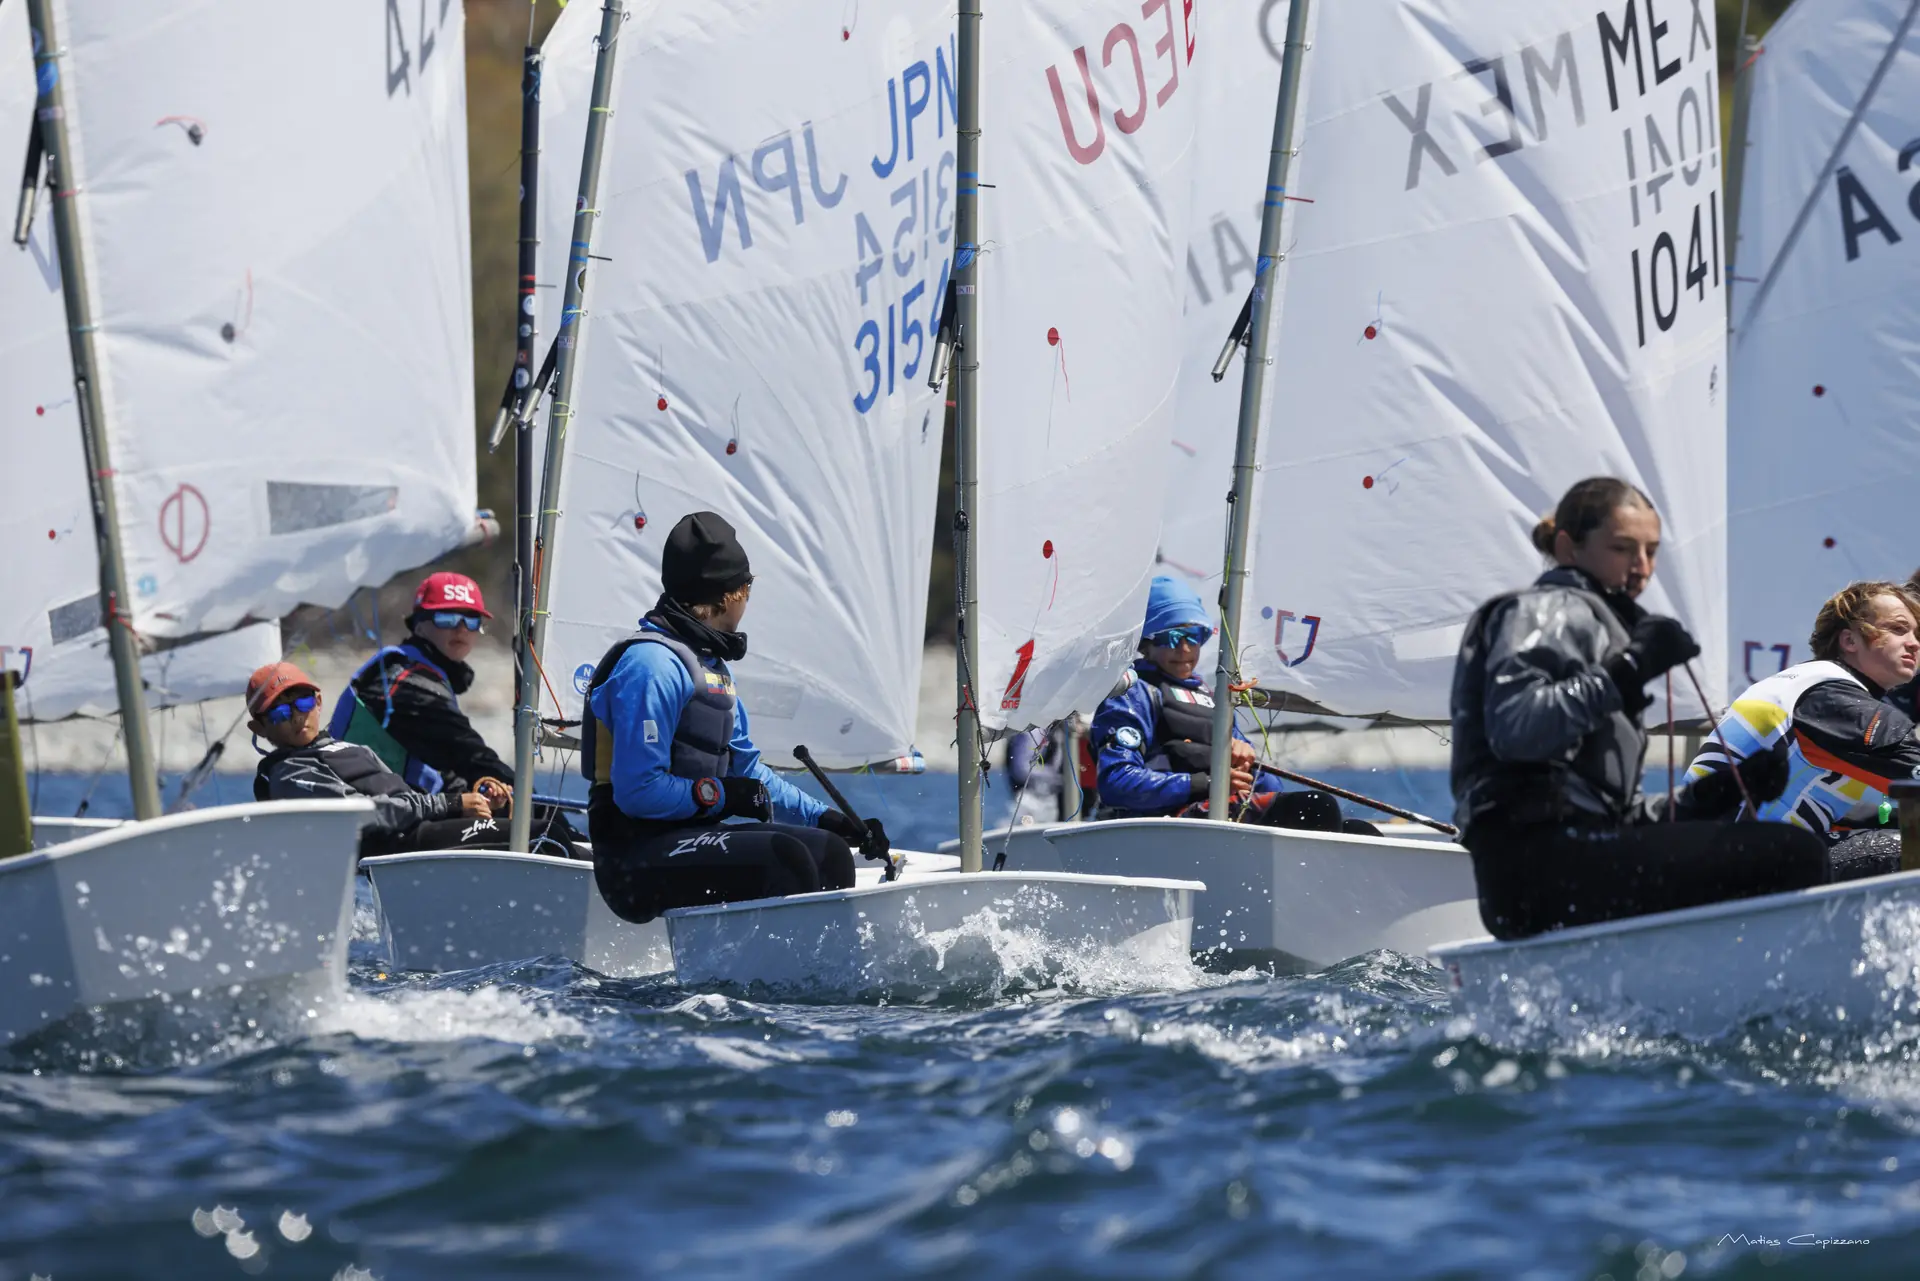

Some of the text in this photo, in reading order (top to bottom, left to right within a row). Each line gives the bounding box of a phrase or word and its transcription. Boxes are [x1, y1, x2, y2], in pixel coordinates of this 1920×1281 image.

[870, 33, 958, 179] JPN
[1597, 0, 1712, 112] MEX
[1631, 190, 1720, 348] 1041
[443, 583, 476, 605] SSL
